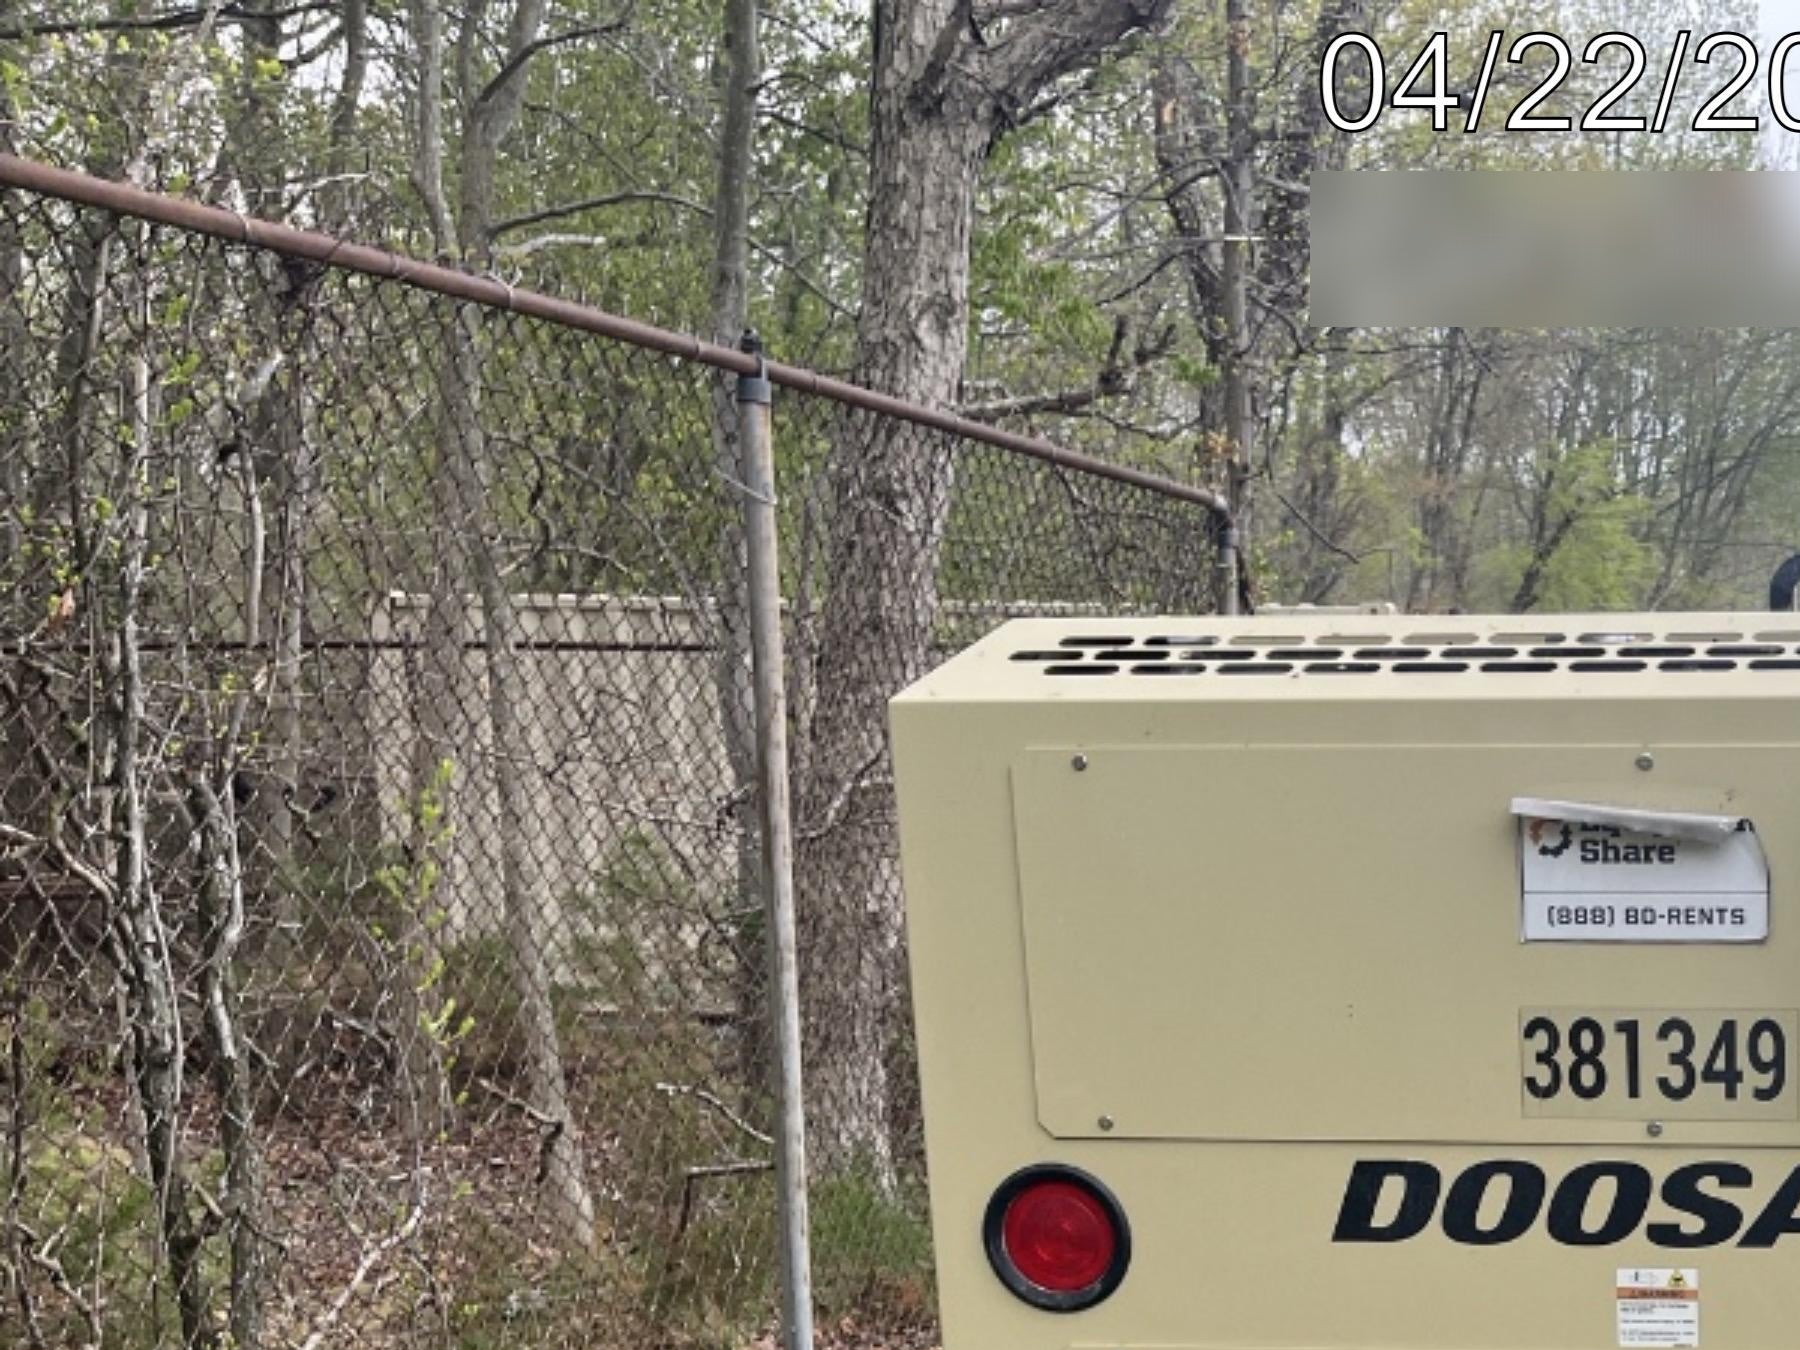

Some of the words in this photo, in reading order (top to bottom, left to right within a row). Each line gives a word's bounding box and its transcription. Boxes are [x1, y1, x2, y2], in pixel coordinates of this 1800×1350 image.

[1579, 839, 1676, 865] Share
[1547, 905, 1616, 927] (888)
[1522, 1016, 1786, 1101] 381349
